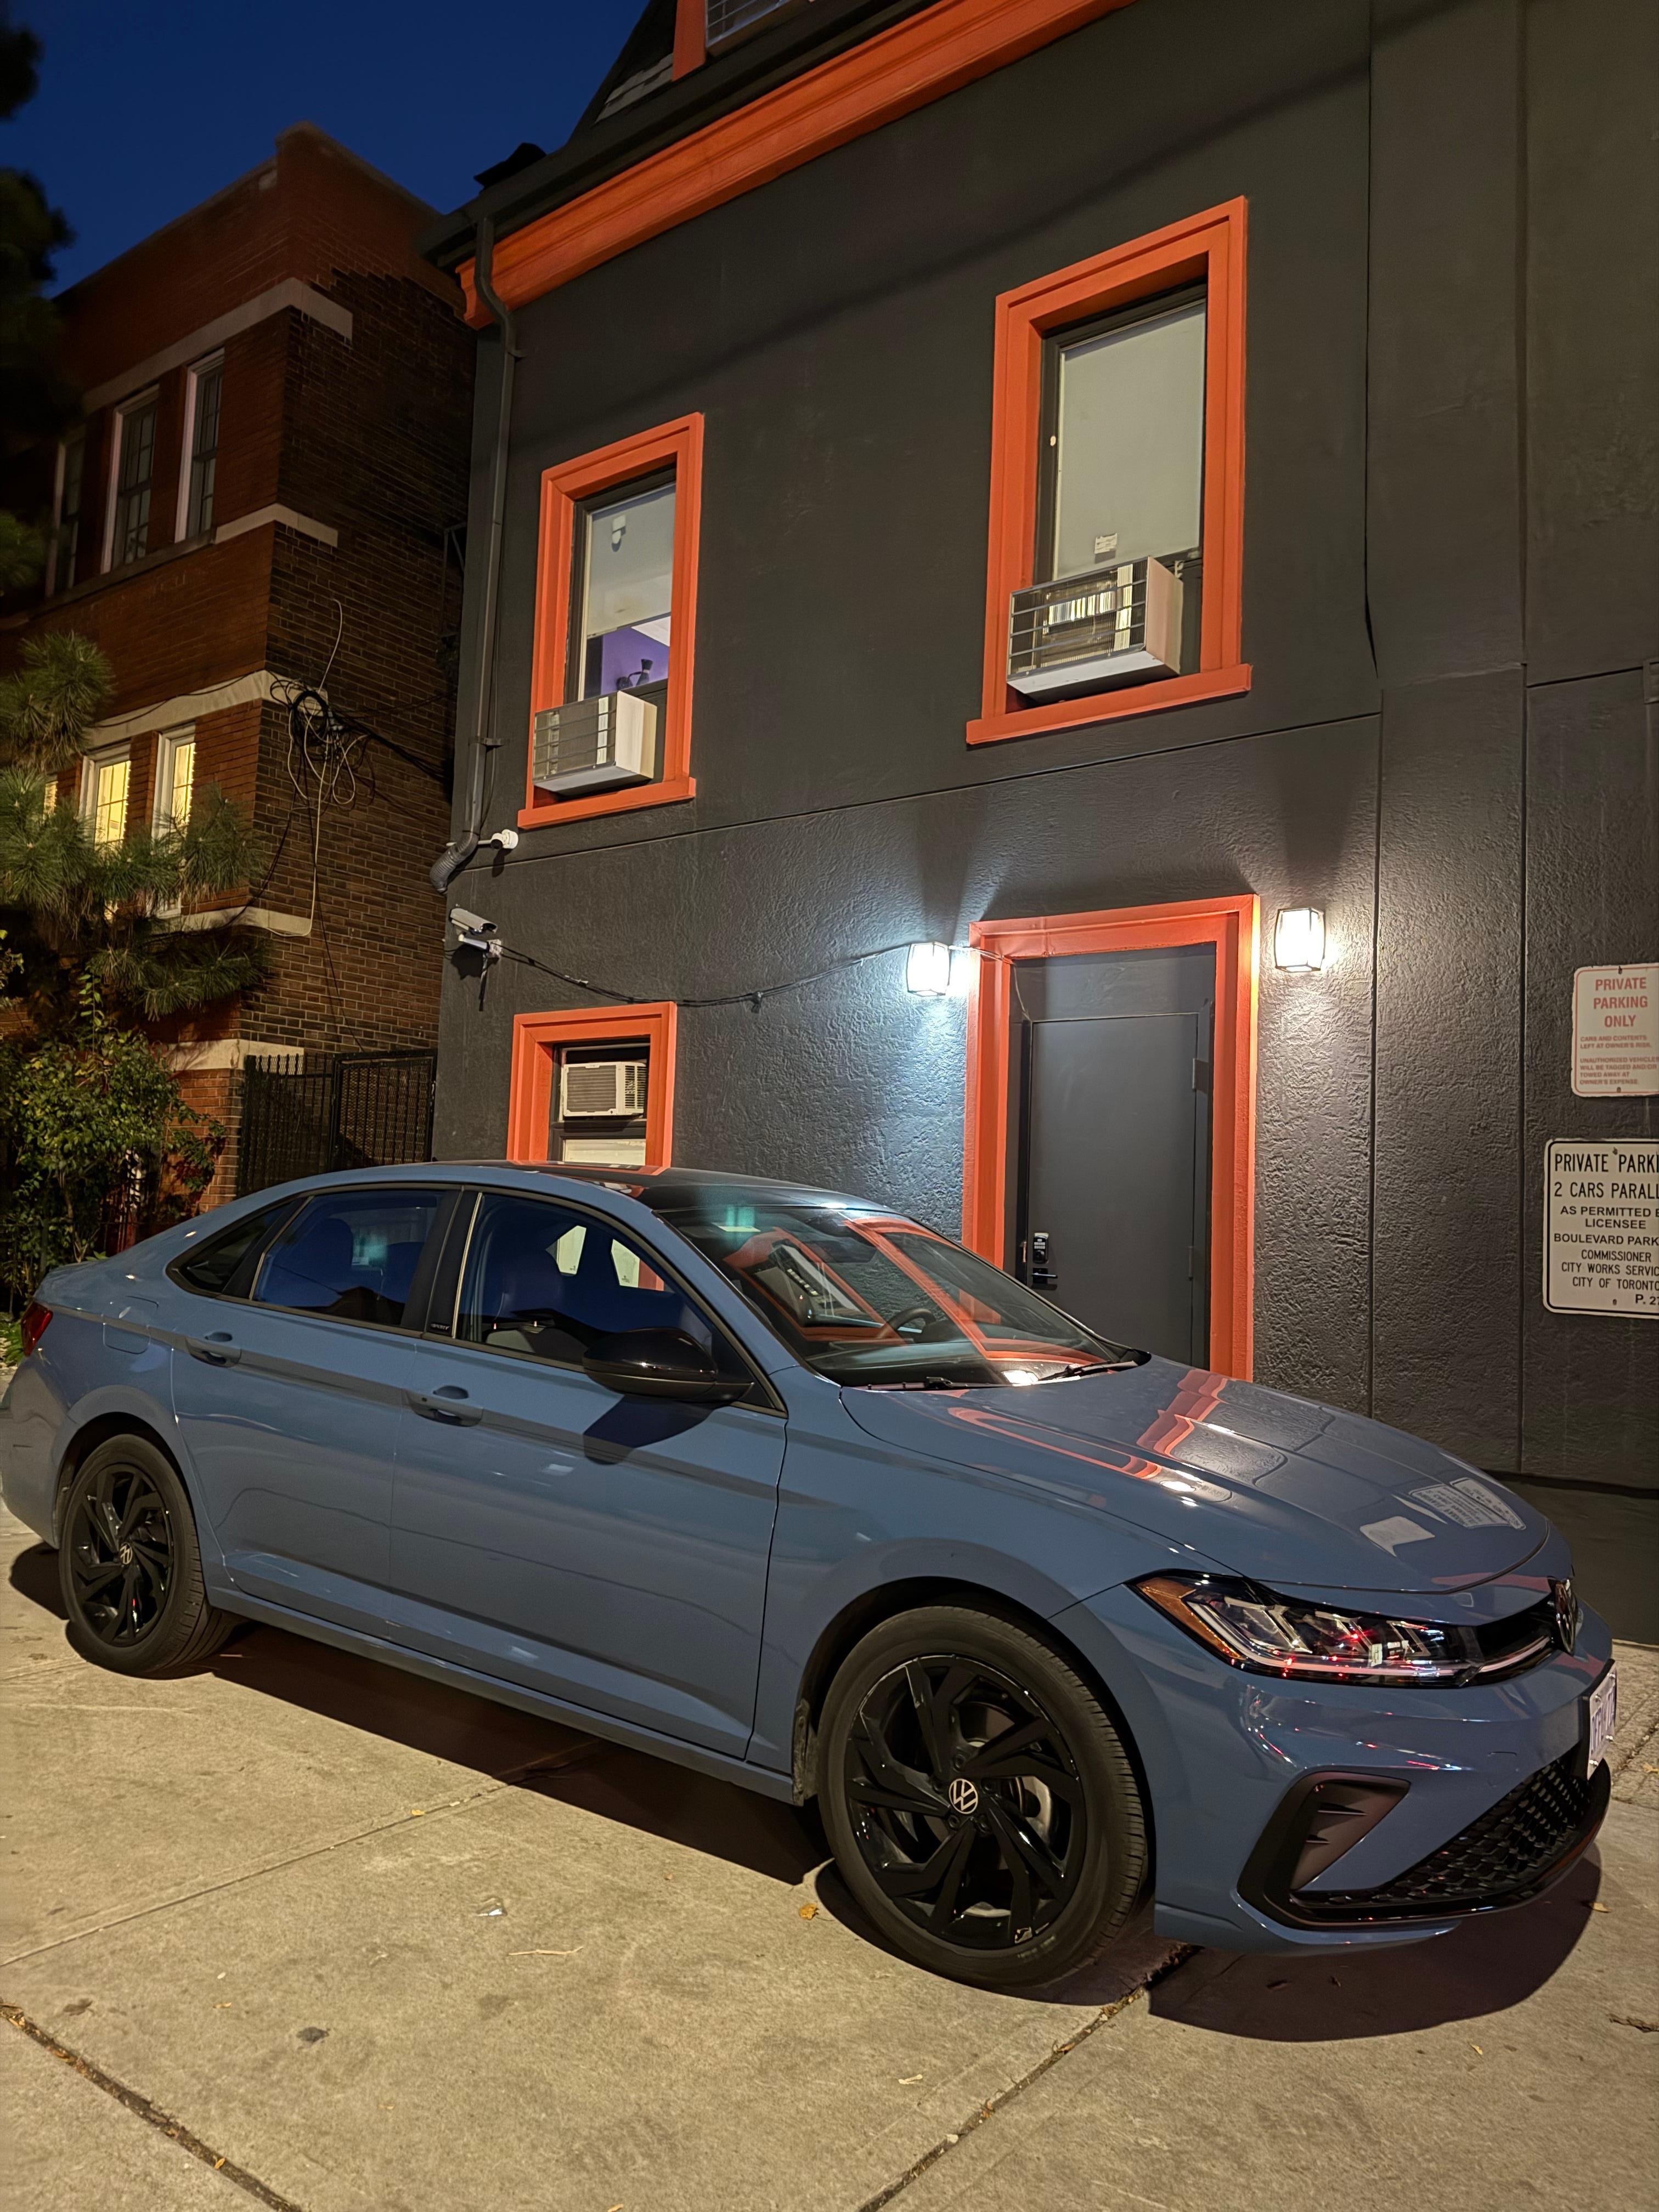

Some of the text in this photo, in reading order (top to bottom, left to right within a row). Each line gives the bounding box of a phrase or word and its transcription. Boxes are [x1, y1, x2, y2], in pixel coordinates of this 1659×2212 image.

[1595, 977, 1647, 991] PRIVATE
[1593, 996, 1648, 1009] PARKING
[1604, 1015, 1637, 1028] ONLY
[1555, 1154, 1609, 1172] PRIVATE
[1554, 1182, 1562, 1197] 2
[1570, 1182, 1604, 1198] CARS
[1560, 1206, 1577, 1215] AS
[1581, 1206, 1651, 1217] PERMITTED
[1585, 1218, 1646, 1229] LICENSEE
[1554, 1233, 1659, 1246] BOULEVARD PARK
[1581, 1250, 1652, 1262] COMMISSIONER
[1561, 1262, 1582, 1272] CITY
[1588, 1263, 1621, 1274] WORKS
[1572, 1277, 1593, 1288] CITY
[1599, 1278, 1611, 1288] OF
[1635, 1294, 1646, 1304] P.
[949, 1778, 978, 1814] VW
